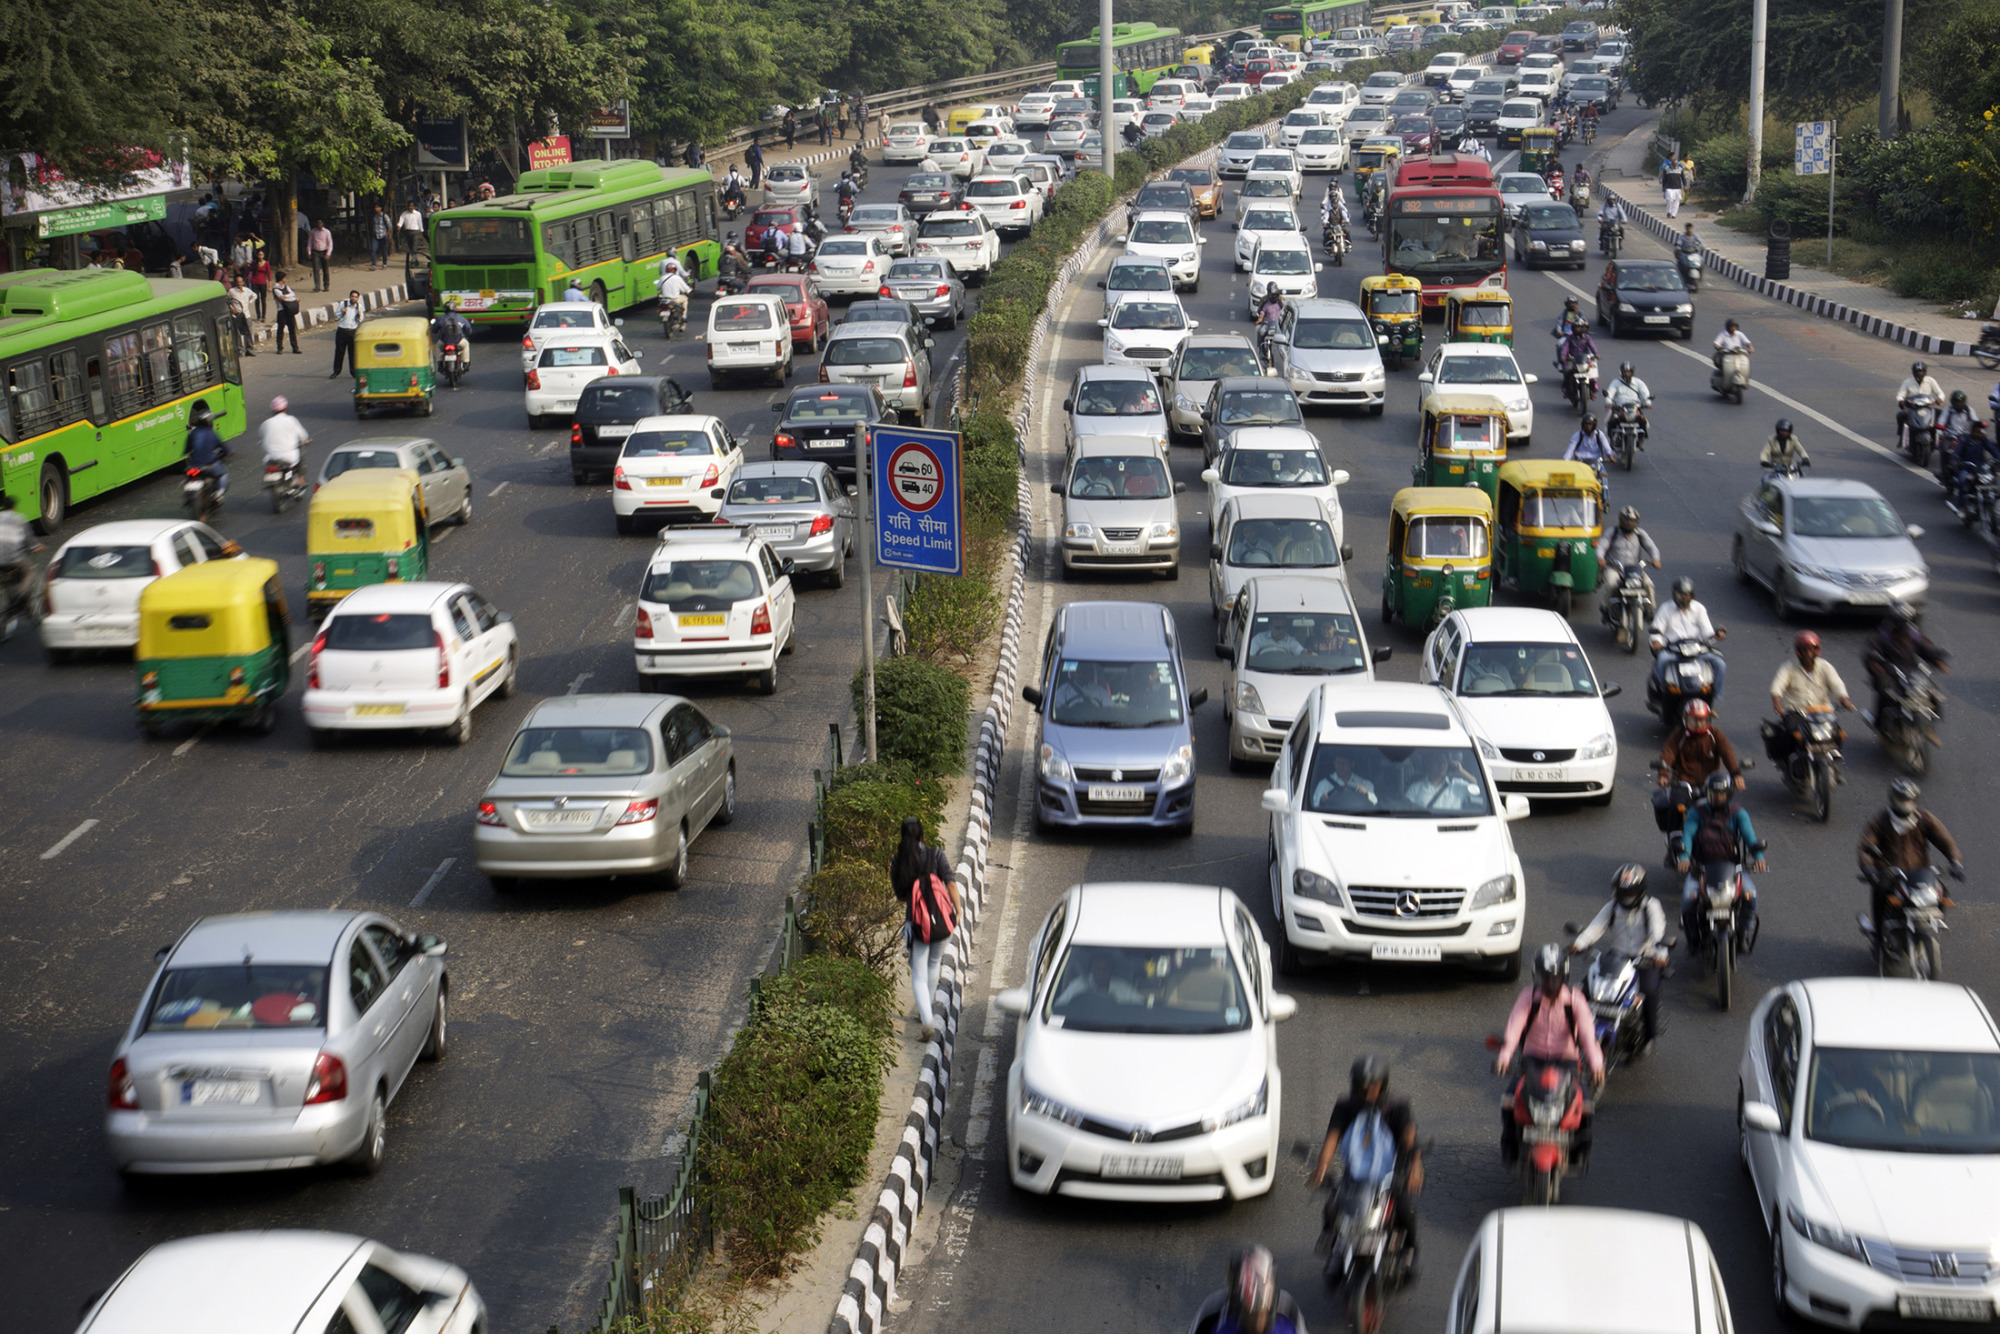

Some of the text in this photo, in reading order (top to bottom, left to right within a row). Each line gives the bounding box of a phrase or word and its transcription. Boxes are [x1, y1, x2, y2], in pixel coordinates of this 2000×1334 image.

[541, 137, 557, 147] AY
[534, 147, 567, 158] ONLINE
[533, 158, 570, 169] RTO-TAX
[1404, 200, 1422, 213] 392
[921, 463, 933, 476] 60
[922, 483, 934, 494] 40
[887, 511, 948, 535] गति सीमा
[884, 531, 953, 551] Speed Limit
[1463, 574, 1475, 585] CNG
[1376, 946, 1388, 955] UP
